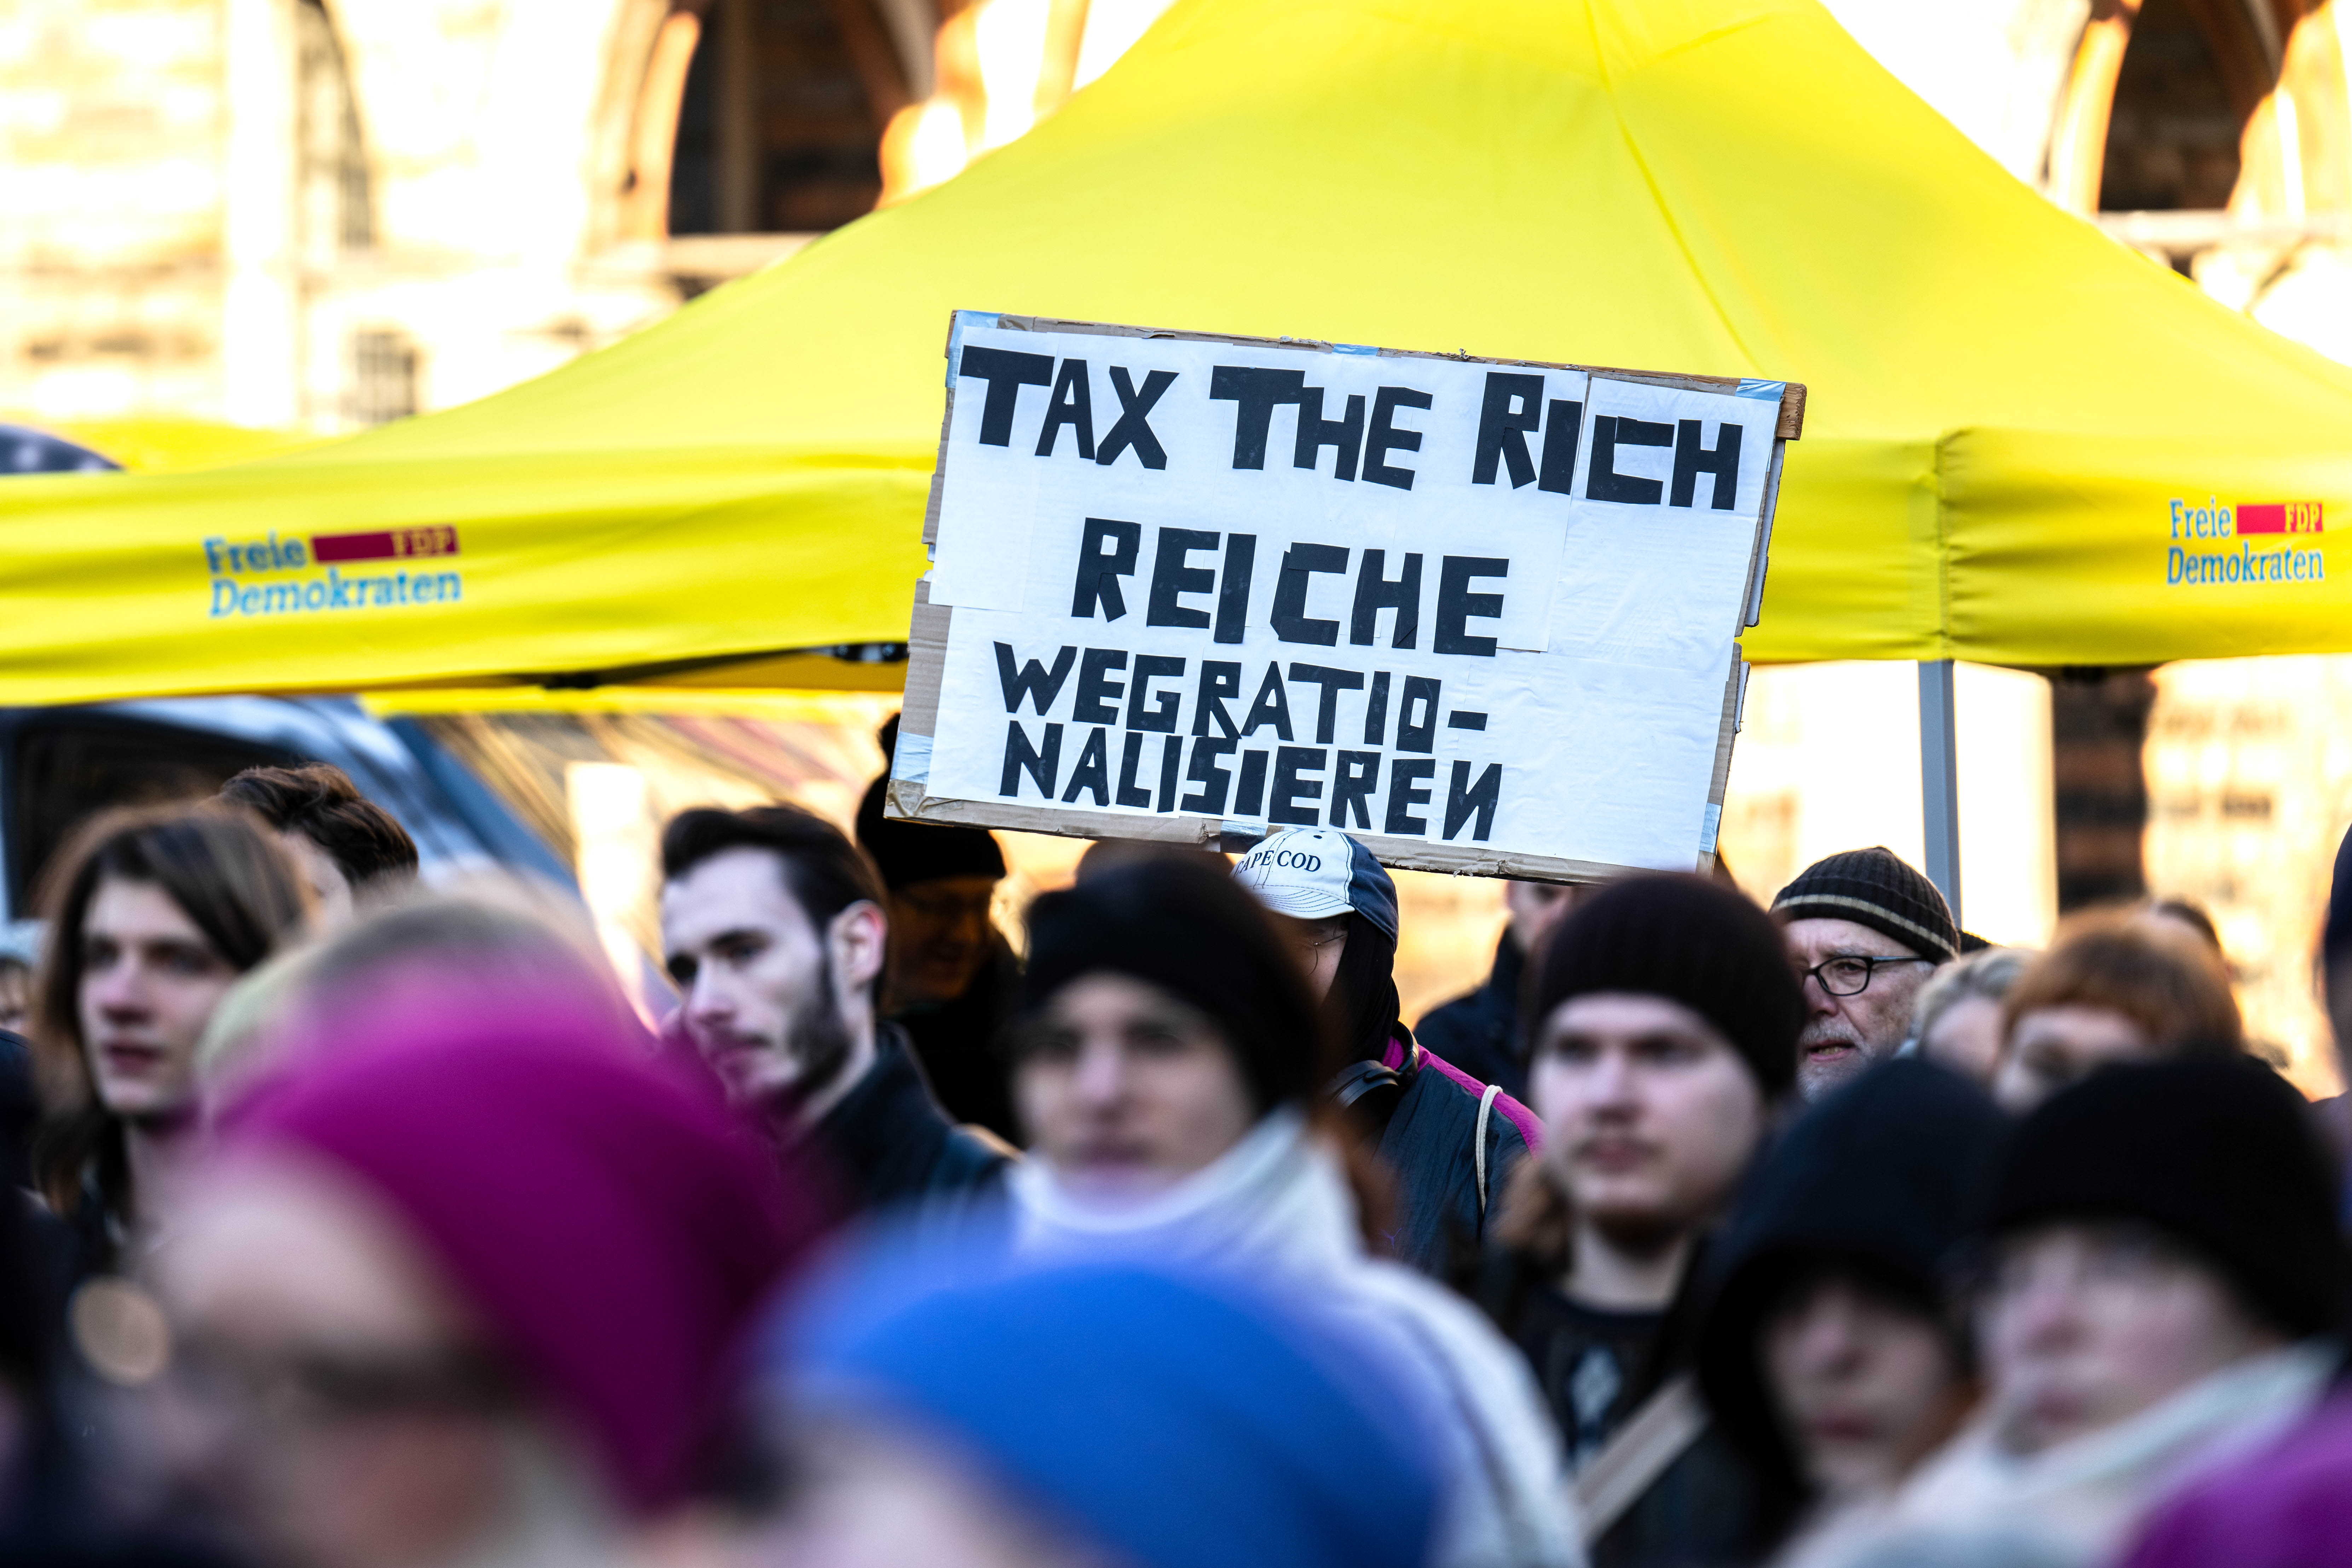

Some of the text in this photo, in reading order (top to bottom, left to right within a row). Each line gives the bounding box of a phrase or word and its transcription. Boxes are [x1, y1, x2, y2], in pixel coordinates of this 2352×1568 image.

[959, 345, 1743, 510] TAX THE RICH
[2169, 496, 2231, 539] Freie
[2284, 503, 2320, 532] FDP
[204, 529, 307, 573] Freie
[2167, 540, 2324, 585] Demokraten
[210, 568, 461, 618] Demokraten
[1071, 517, 1509, 656] REICHE
[994, 641, 1487, 754] WEGRATIO-
[999, 721, 1502, 841] NALISIEREN
[1233, 850, 1321, 878] CAPE COD
